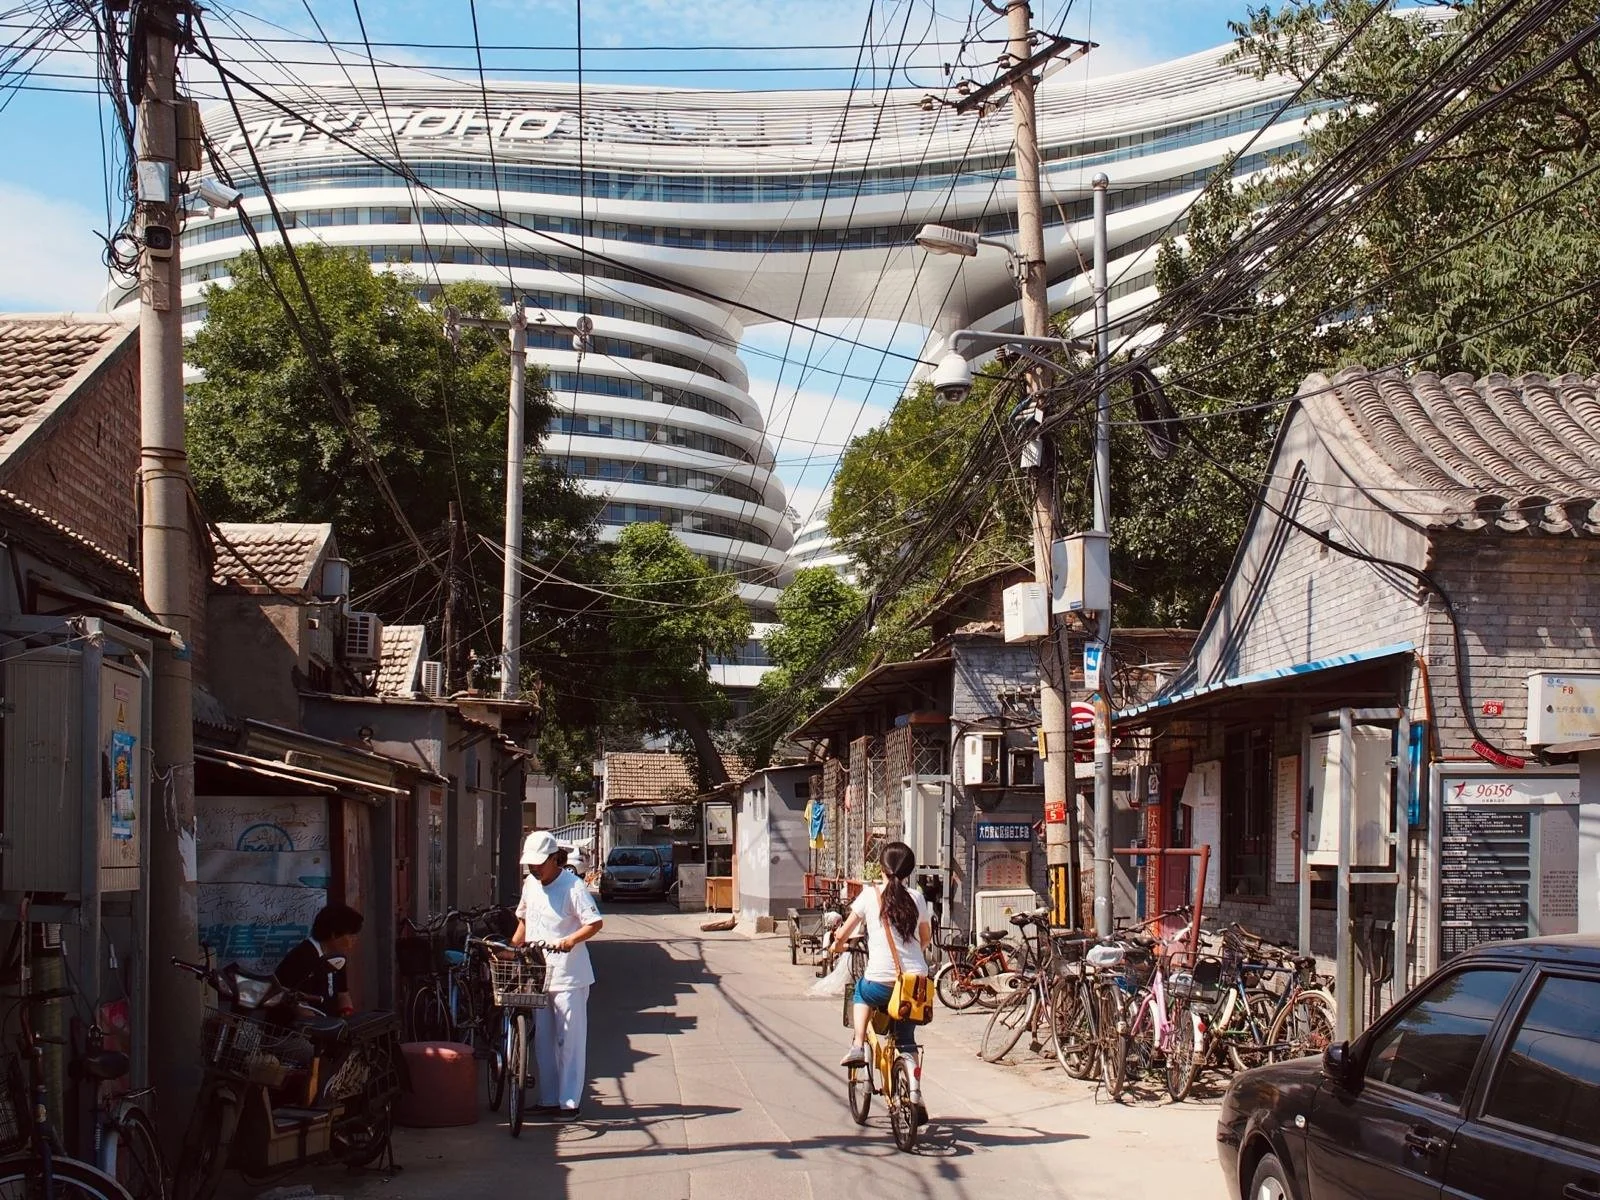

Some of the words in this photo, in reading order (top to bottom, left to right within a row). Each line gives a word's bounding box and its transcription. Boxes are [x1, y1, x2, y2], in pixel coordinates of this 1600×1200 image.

[1487, 705, 1498, 714] 38
[1475, 783, 1514, 797] 96156
[1050, 810, 1057, 820] 5
